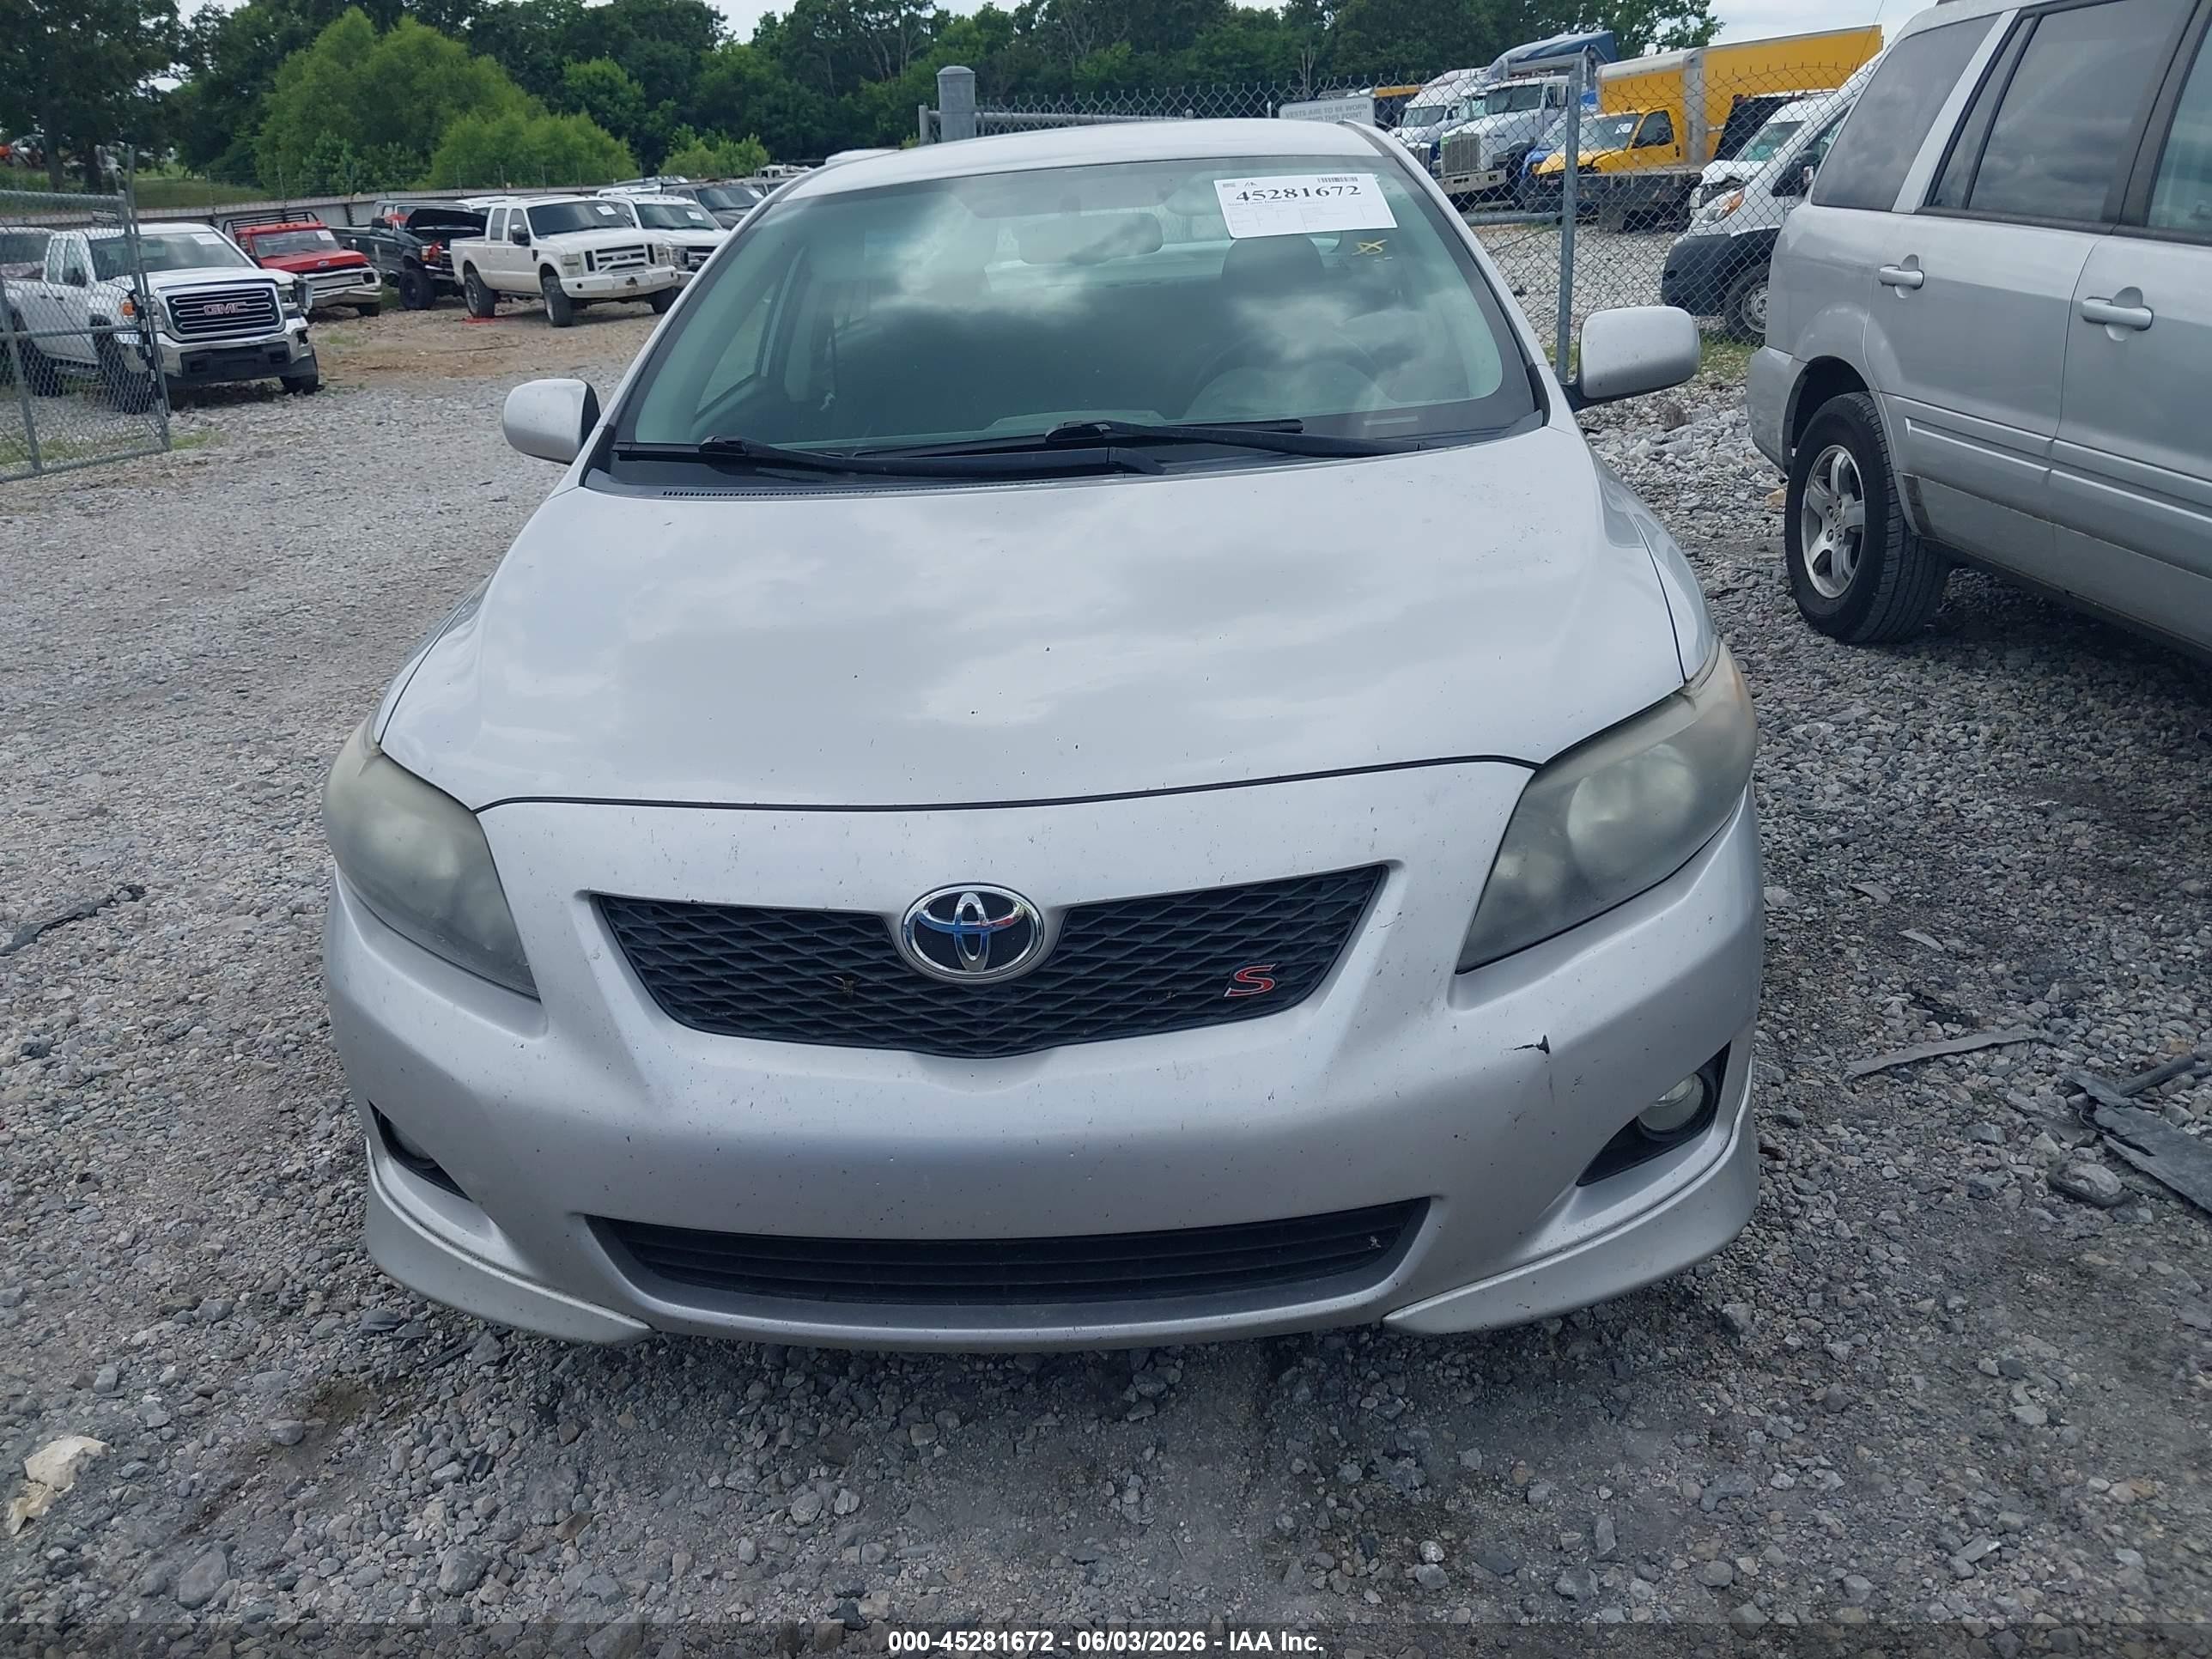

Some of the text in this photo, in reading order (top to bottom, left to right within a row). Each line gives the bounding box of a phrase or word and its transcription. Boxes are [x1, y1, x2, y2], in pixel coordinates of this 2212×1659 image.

[1285, 110, 1306, 118] VESTS
[1345, 103, 1368, 112] WORN
[1236, 185, 1361, 202] 45281672
[203, 301, 247, 316] GMC
[1224, 963, 1276, 997] S
